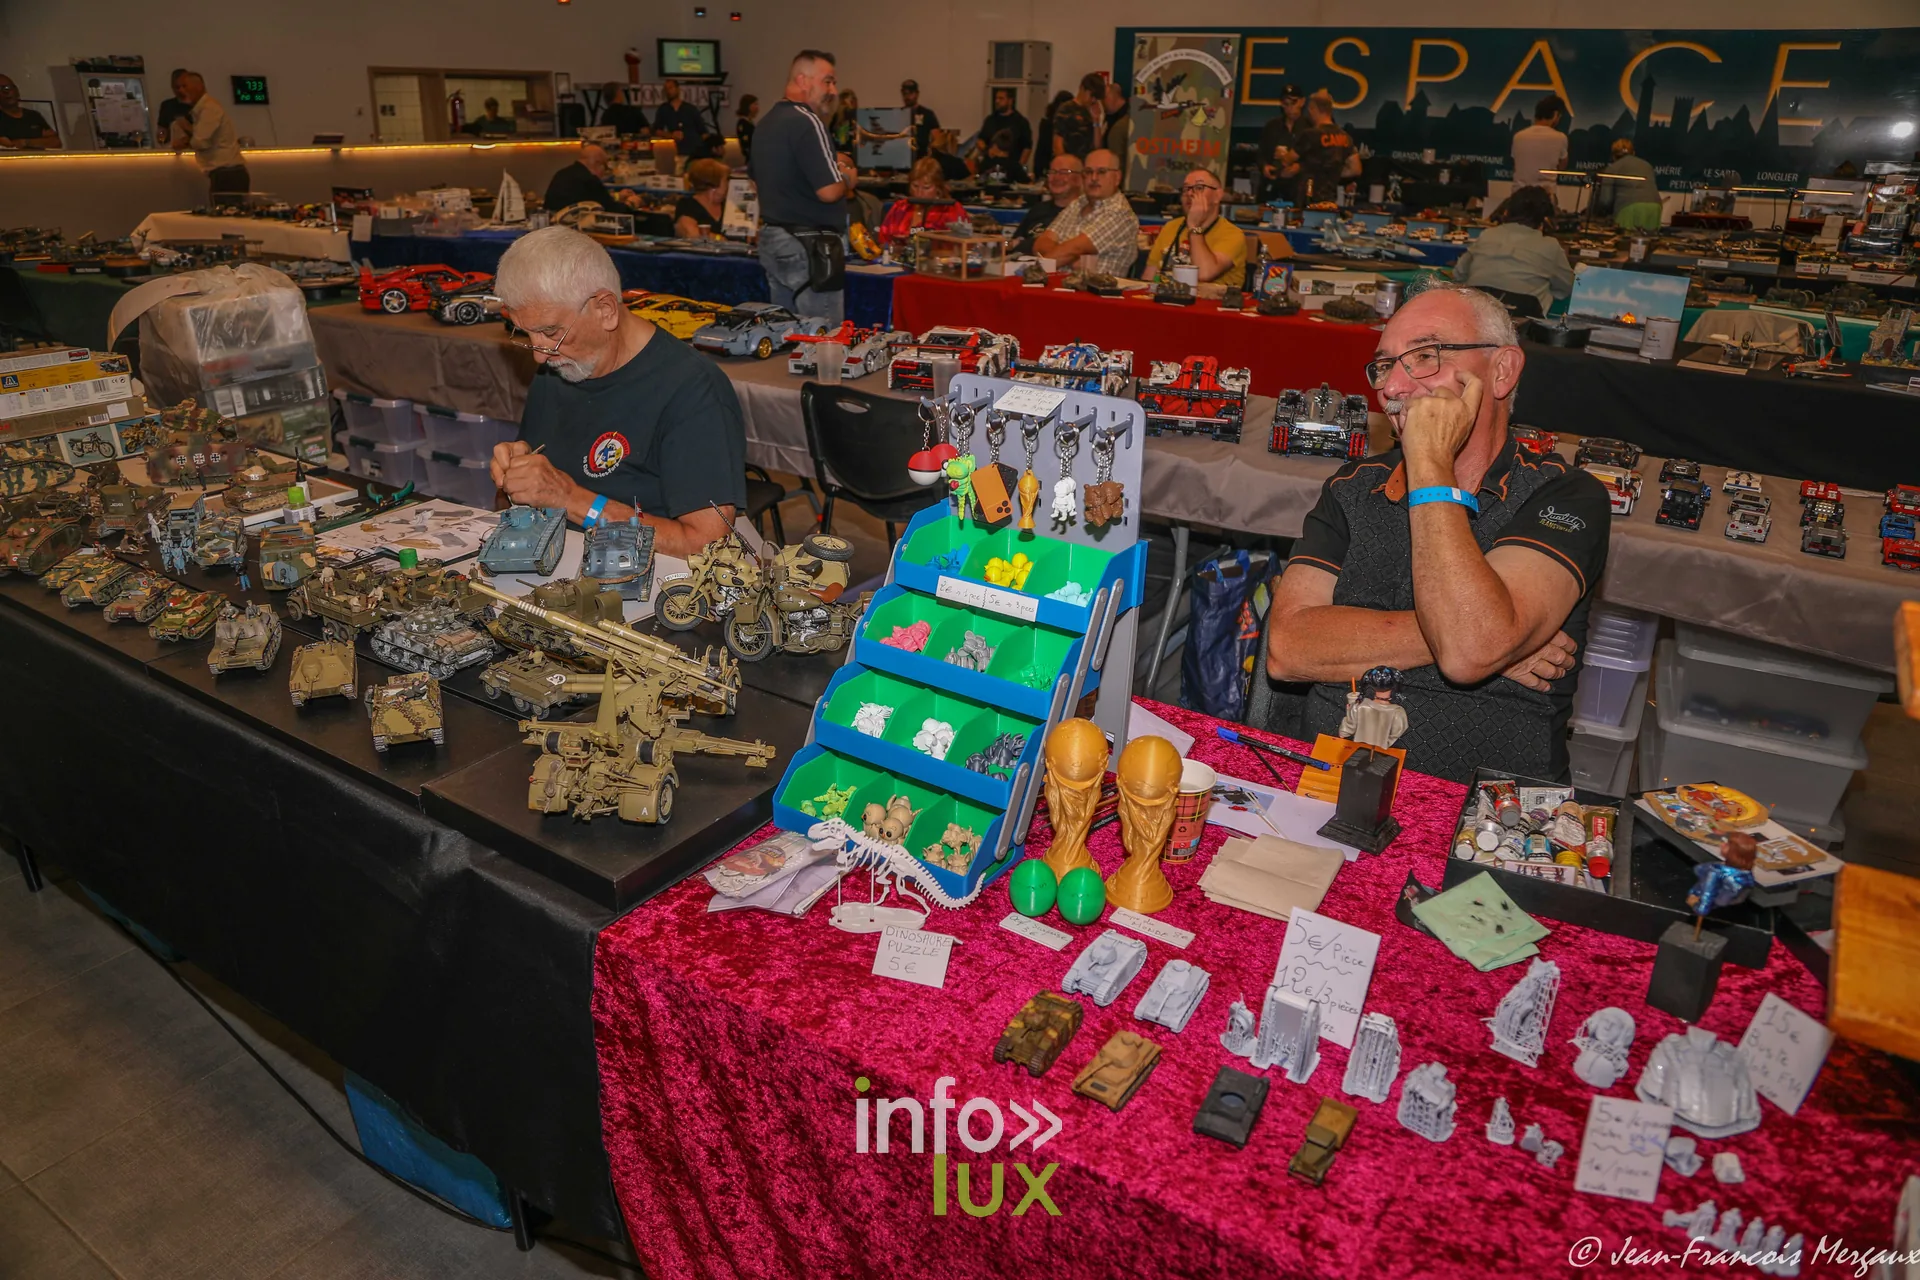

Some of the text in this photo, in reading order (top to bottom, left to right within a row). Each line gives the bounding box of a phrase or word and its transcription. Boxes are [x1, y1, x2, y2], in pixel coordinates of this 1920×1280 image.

[1241, 36, 1842, 126] ESPACE
[1136, 137, 1221, 157] OSTHEIM
[1756, 171, 1799, 182] LONGLIER
[888, 940, 940, 957] PUZZLE
